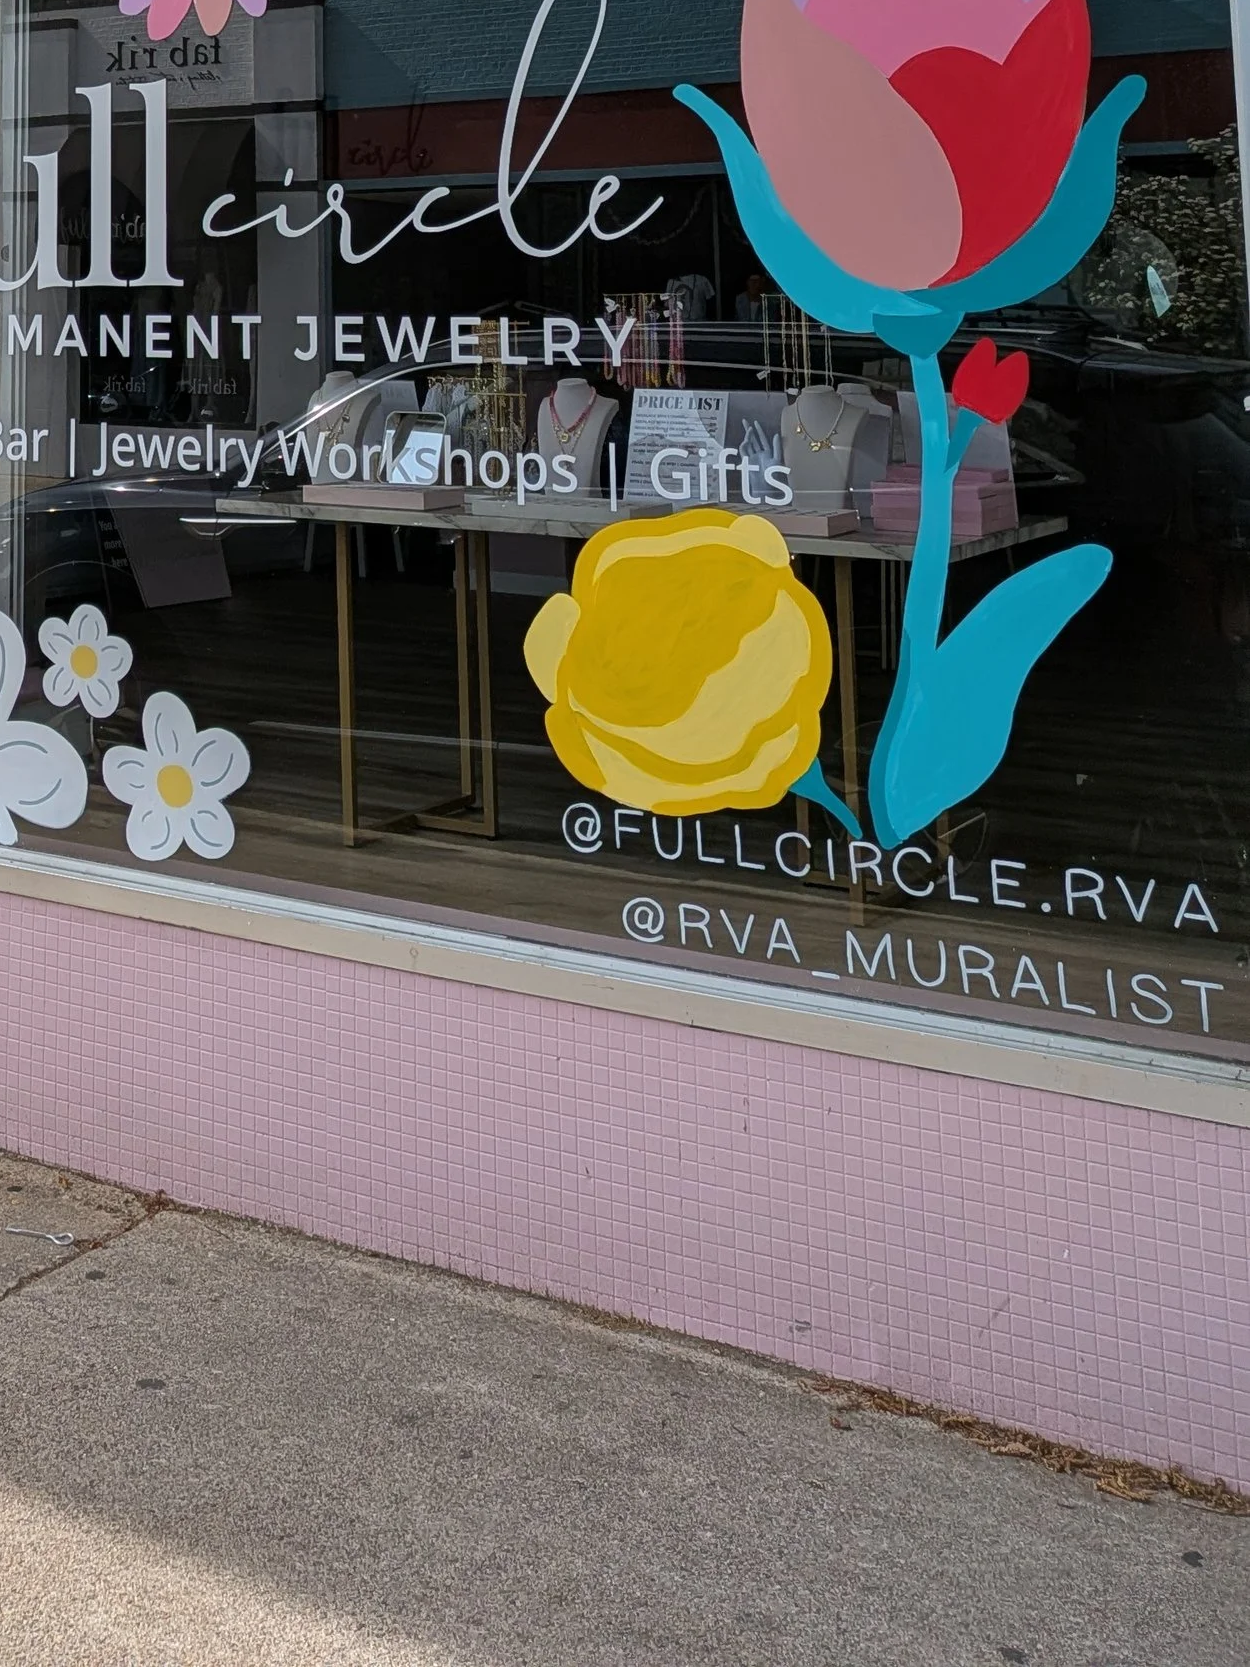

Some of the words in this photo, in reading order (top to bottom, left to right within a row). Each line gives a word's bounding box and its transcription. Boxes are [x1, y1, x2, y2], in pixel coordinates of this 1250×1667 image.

[295, 315, 637, 367] JEWELRY
[637, 395, 684, 411] PRICE
[689, 397, 724, 411] LIST
[92, 422, 265, 489] Jewelry
[278, 429, 578, 506] Workshops
[650, 447, 794, 507] Gifts
[562, 802, 1218, 933] @FULLCIRCLE.RVA
[622, 897, 1224, 1033] @RVA_MURALIST
